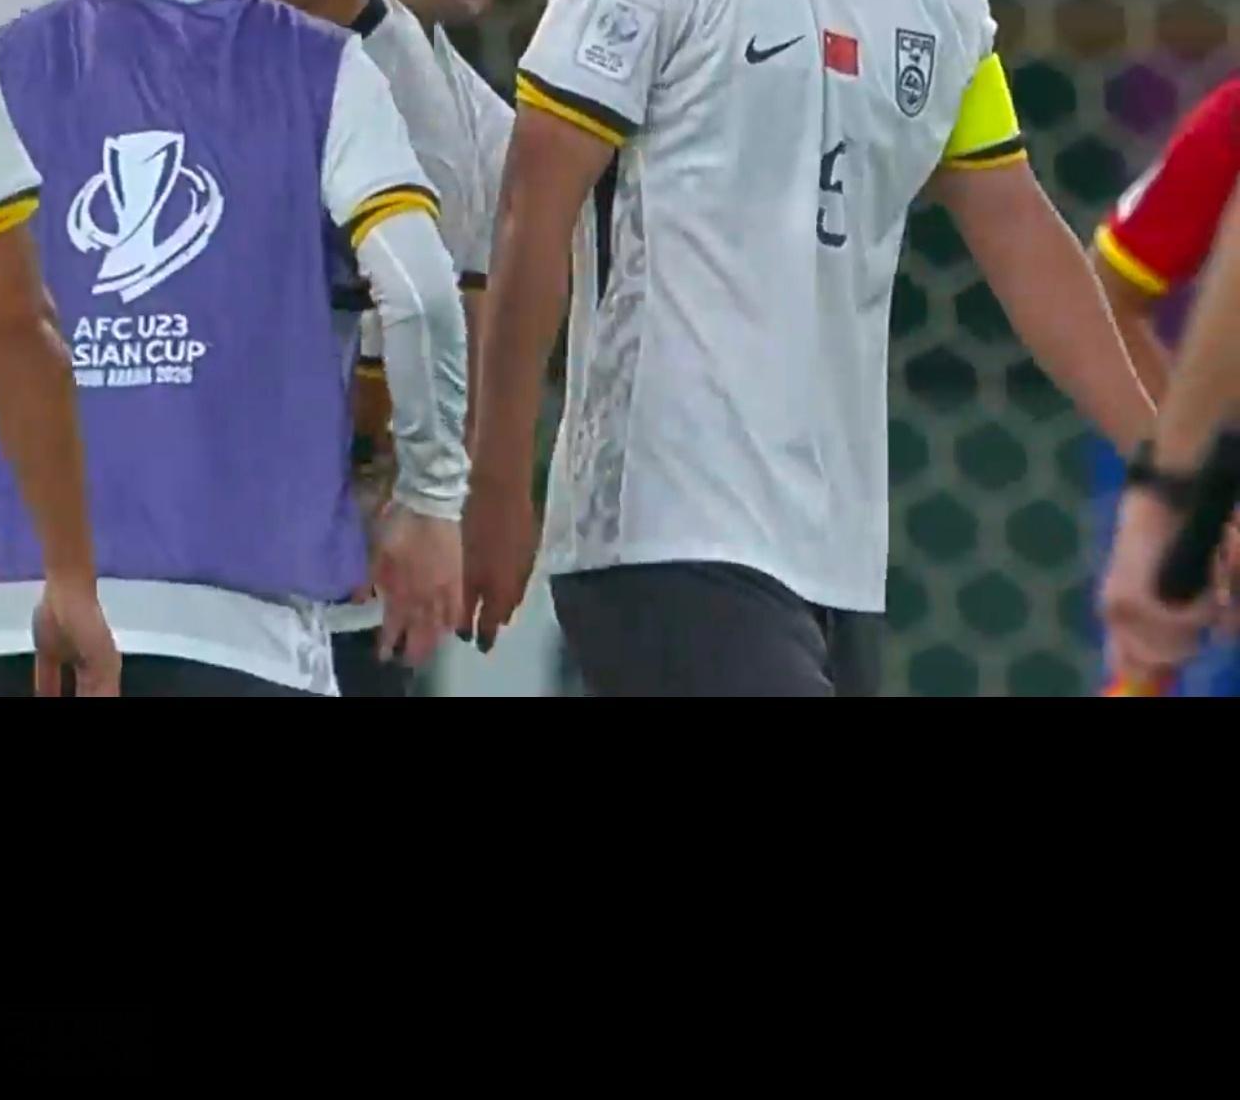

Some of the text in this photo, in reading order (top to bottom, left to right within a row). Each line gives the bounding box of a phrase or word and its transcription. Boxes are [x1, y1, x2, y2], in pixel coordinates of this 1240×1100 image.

[73, 313, 189, 341] AFC U23
[72, 339, 207, 367] SIAN CUP
